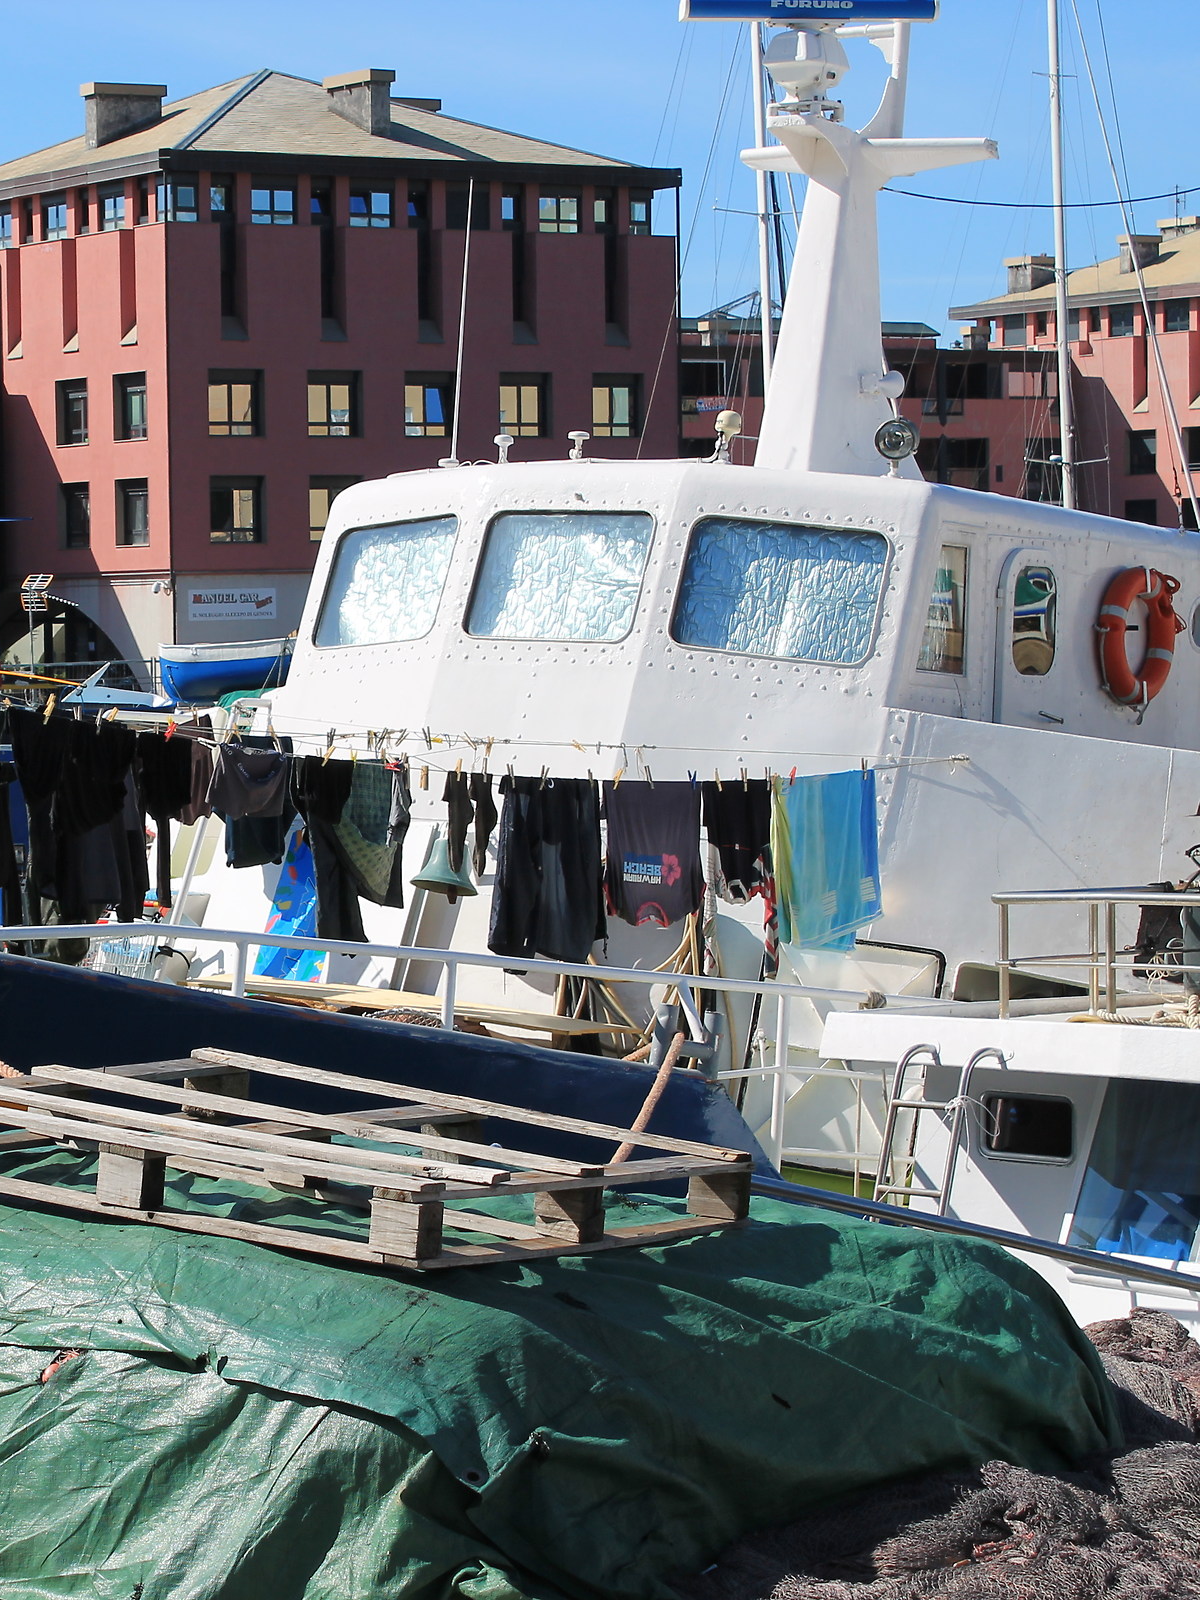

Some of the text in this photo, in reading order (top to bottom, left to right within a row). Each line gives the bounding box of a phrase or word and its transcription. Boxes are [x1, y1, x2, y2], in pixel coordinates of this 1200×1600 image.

[771, 0, 853, 9] FURUNO
[193, 594, 237, 603] MANUEL
[240, 594, 259, 603] CAR
[624, 862, 661, 875] BEACH
[624, 874, 661, 884] HAWAIIAN
